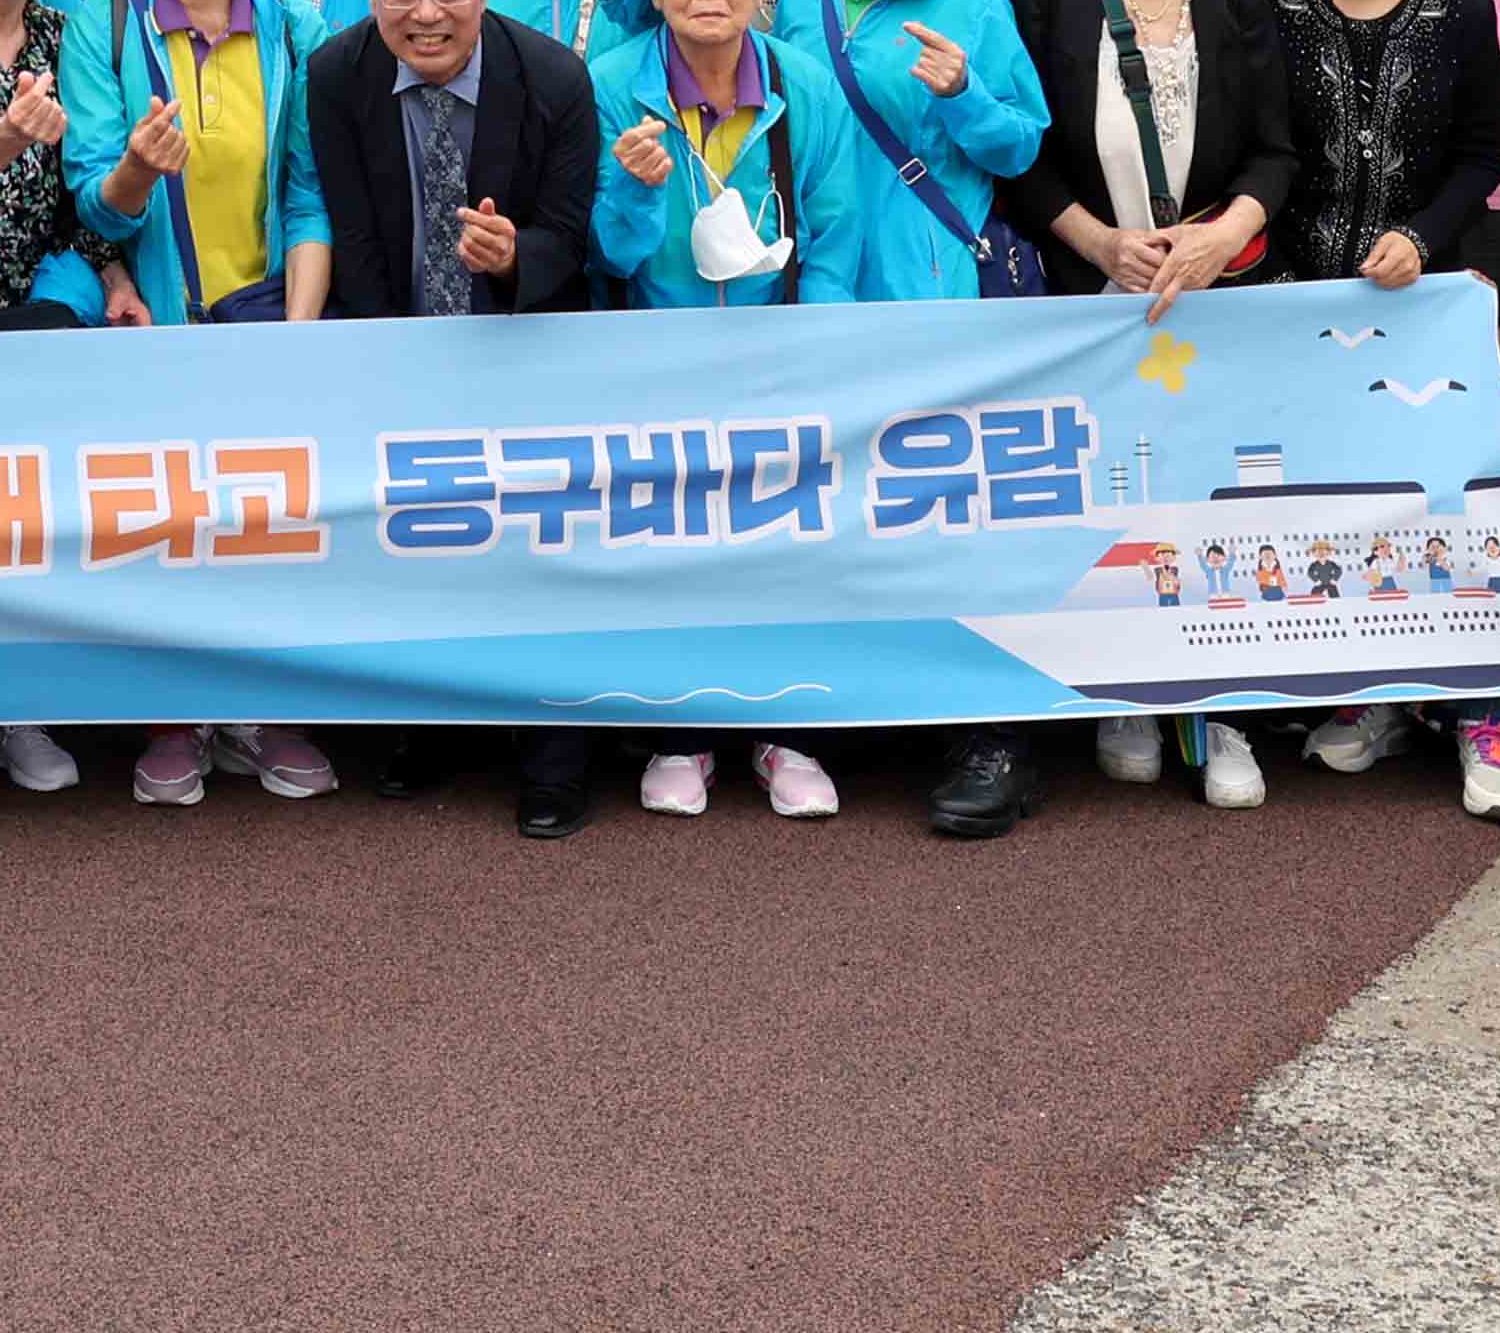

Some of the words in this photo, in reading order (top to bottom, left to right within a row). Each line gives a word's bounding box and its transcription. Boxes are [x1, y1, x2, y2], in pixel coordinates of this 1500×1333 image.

[78, 436, 329, 569] 타고
[375, 415, 841, 557] 동구바다
[865, 396, 1099, 535] 유람
